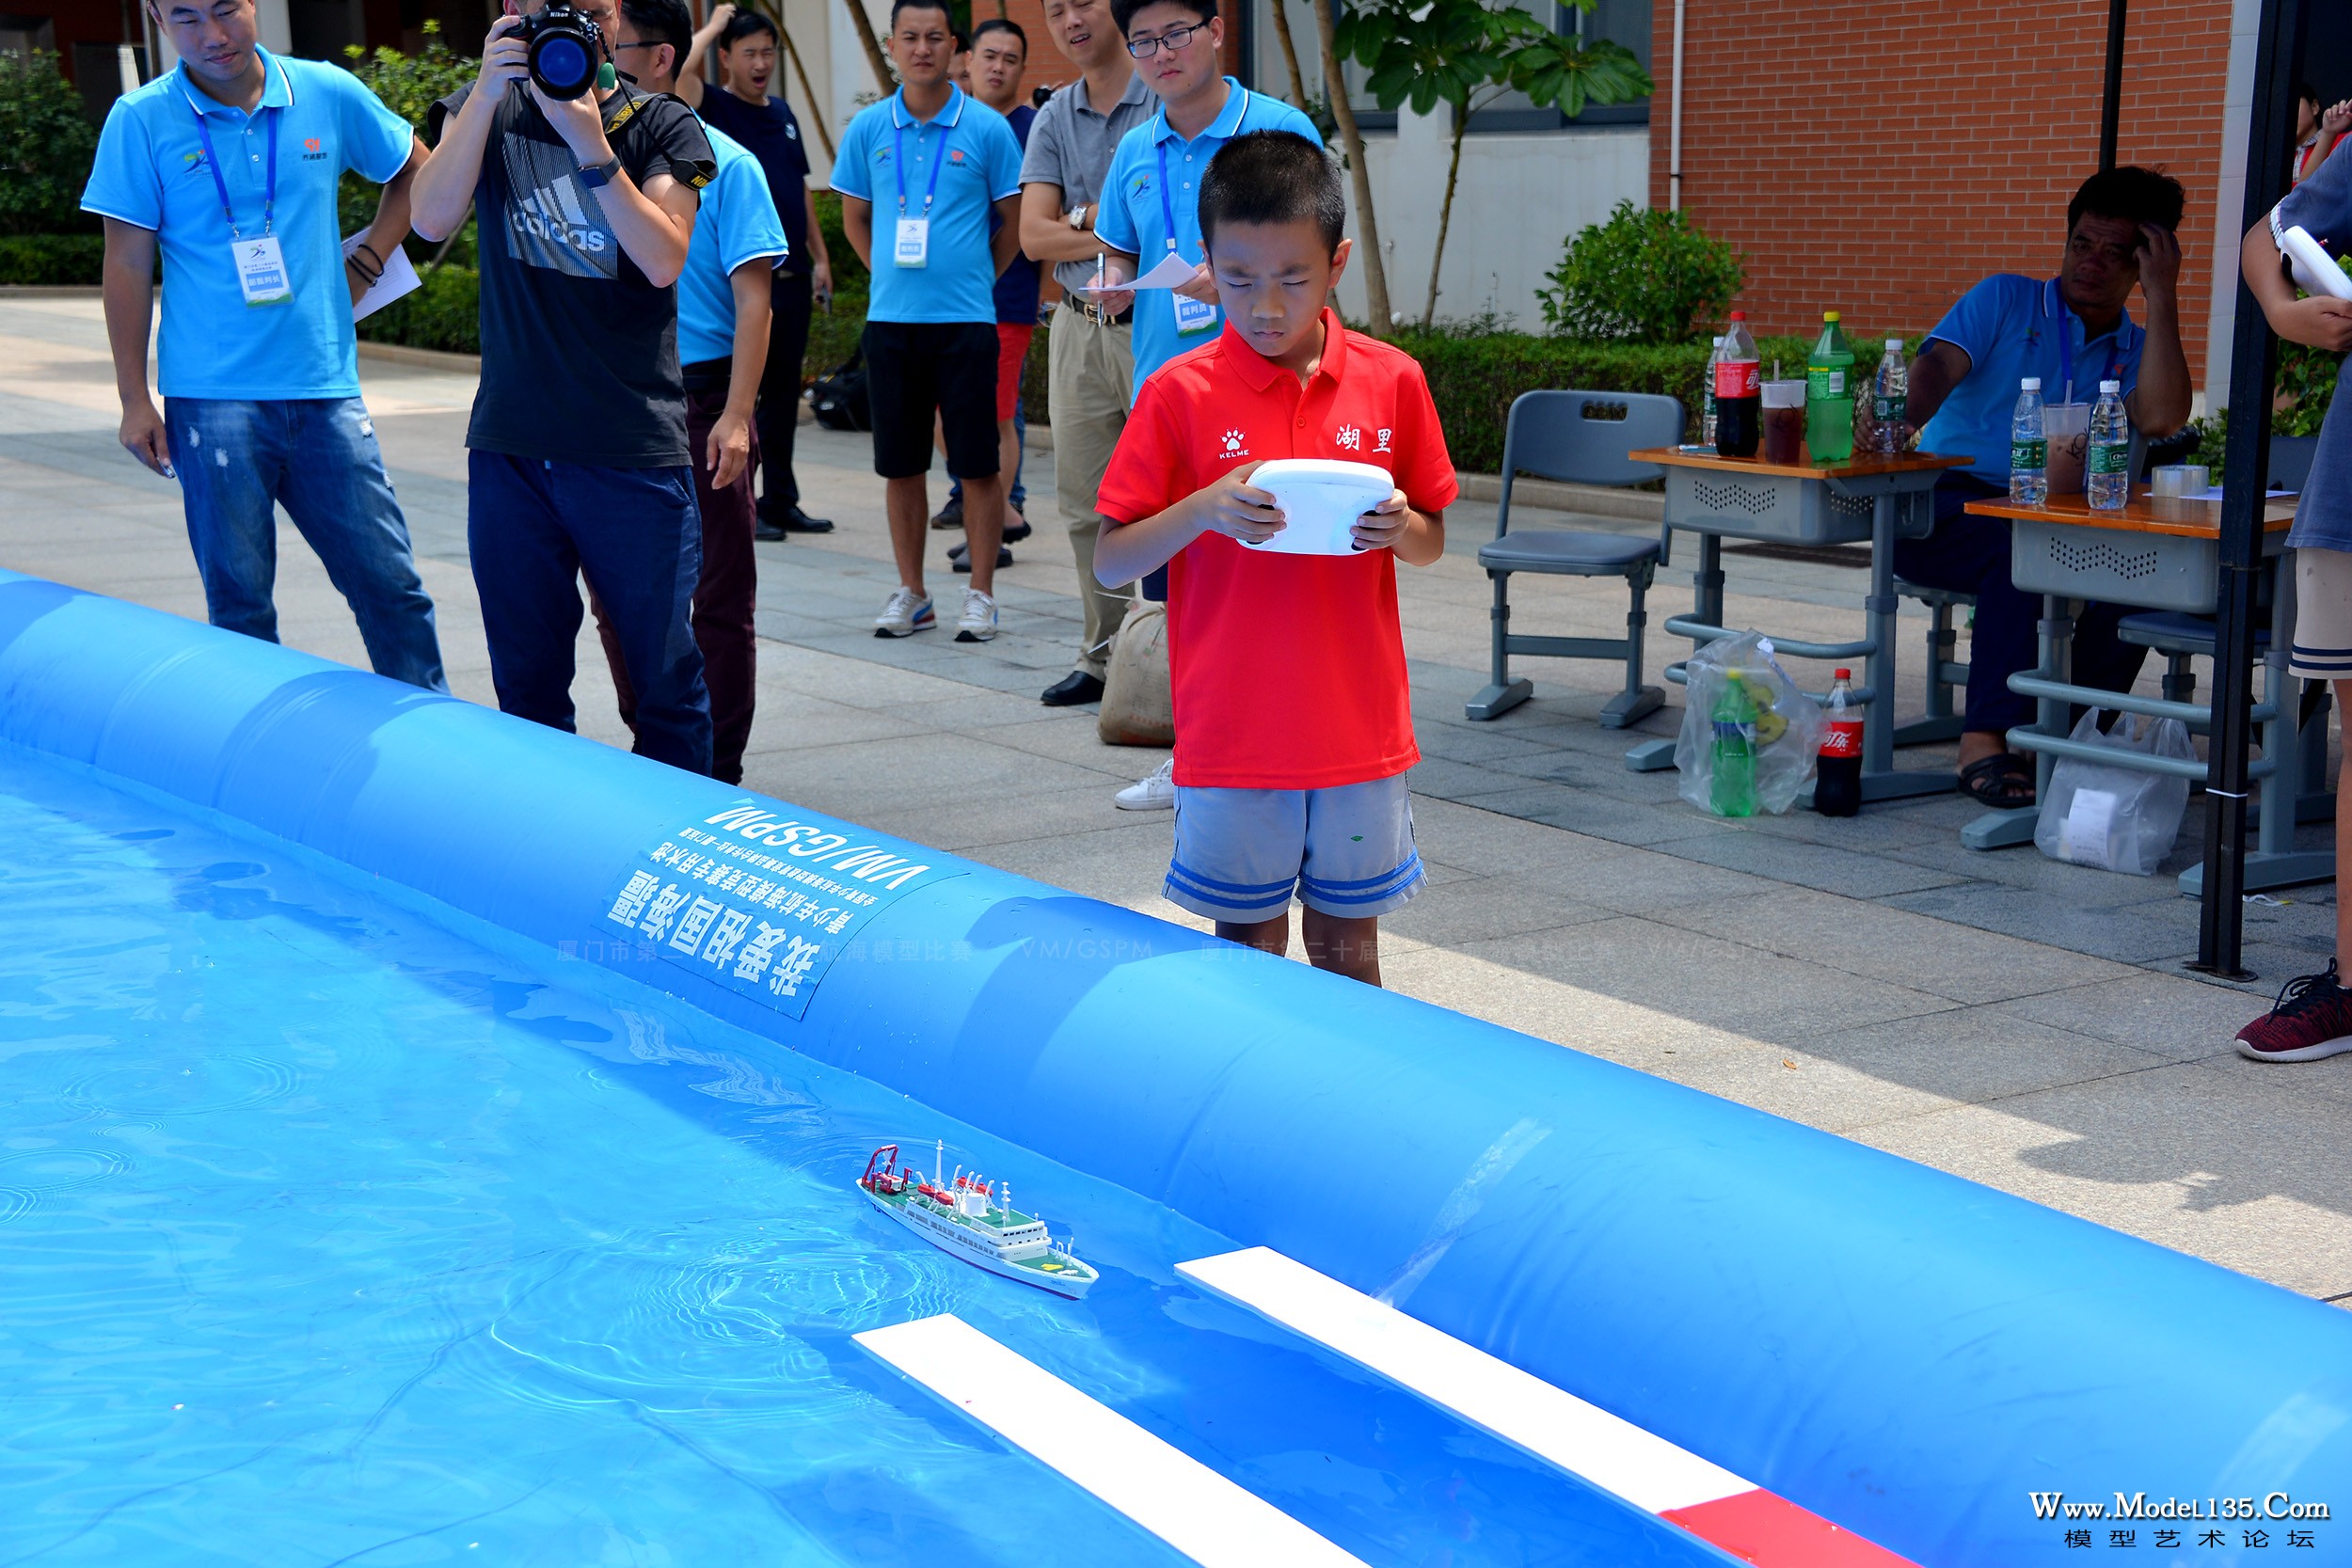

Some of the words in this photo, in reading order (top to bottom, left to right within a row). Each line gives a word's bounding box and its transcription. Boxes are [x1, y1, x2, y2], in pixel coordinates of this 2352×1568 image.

[513, 212, 605, 252] adidas
[1219, 449, 1250, 460] KELME
[1336, 423, 1392, 453] 湖里
[704, 806, 930, 890] VM/GSPM
[650, 842, 854, 934] 青少年航海模型竞赛专用水池
[608, 869, 821, 996] 我爱祖国海疆
